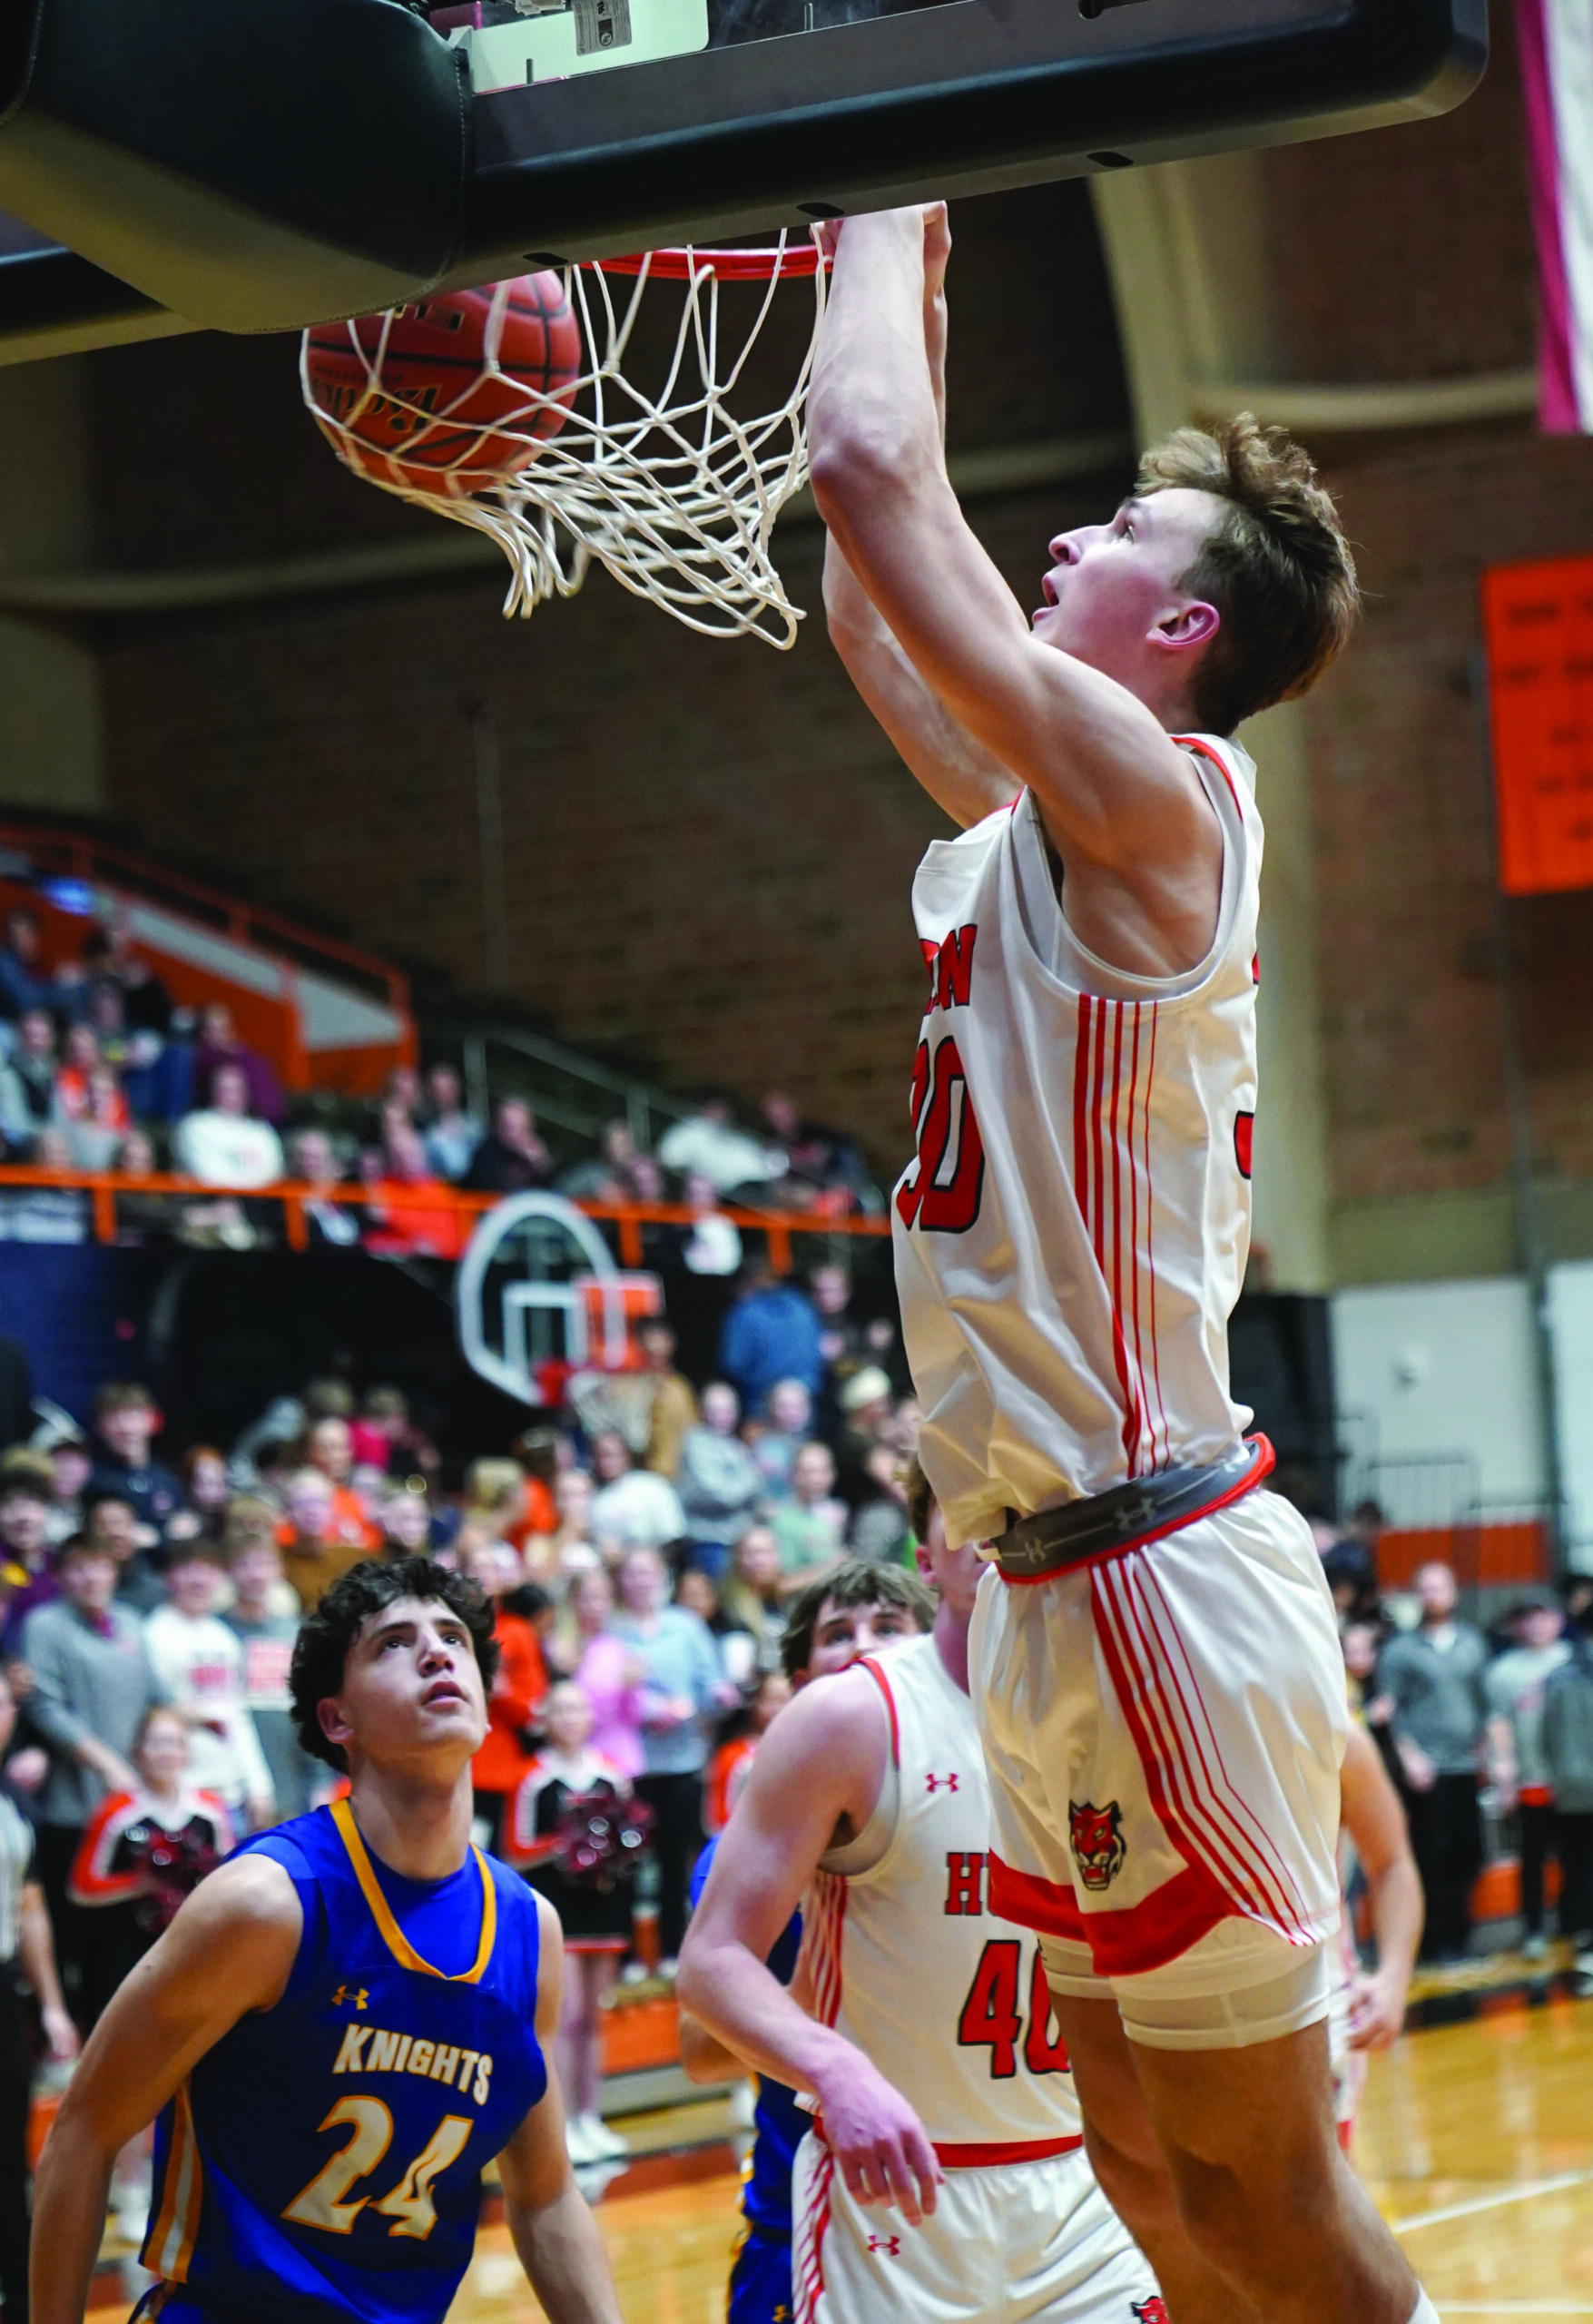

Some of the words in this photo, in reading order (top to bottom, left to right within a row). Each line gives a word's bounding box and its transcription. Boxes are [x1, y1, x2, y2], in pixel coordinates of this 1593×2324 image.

[945, 1852, 996, 1915] H
[959, 1939, 1071, 2079] 40
[333, 2024, 494, 2105] KNIGHTS
[280, 2094, 474, 2240] 24
